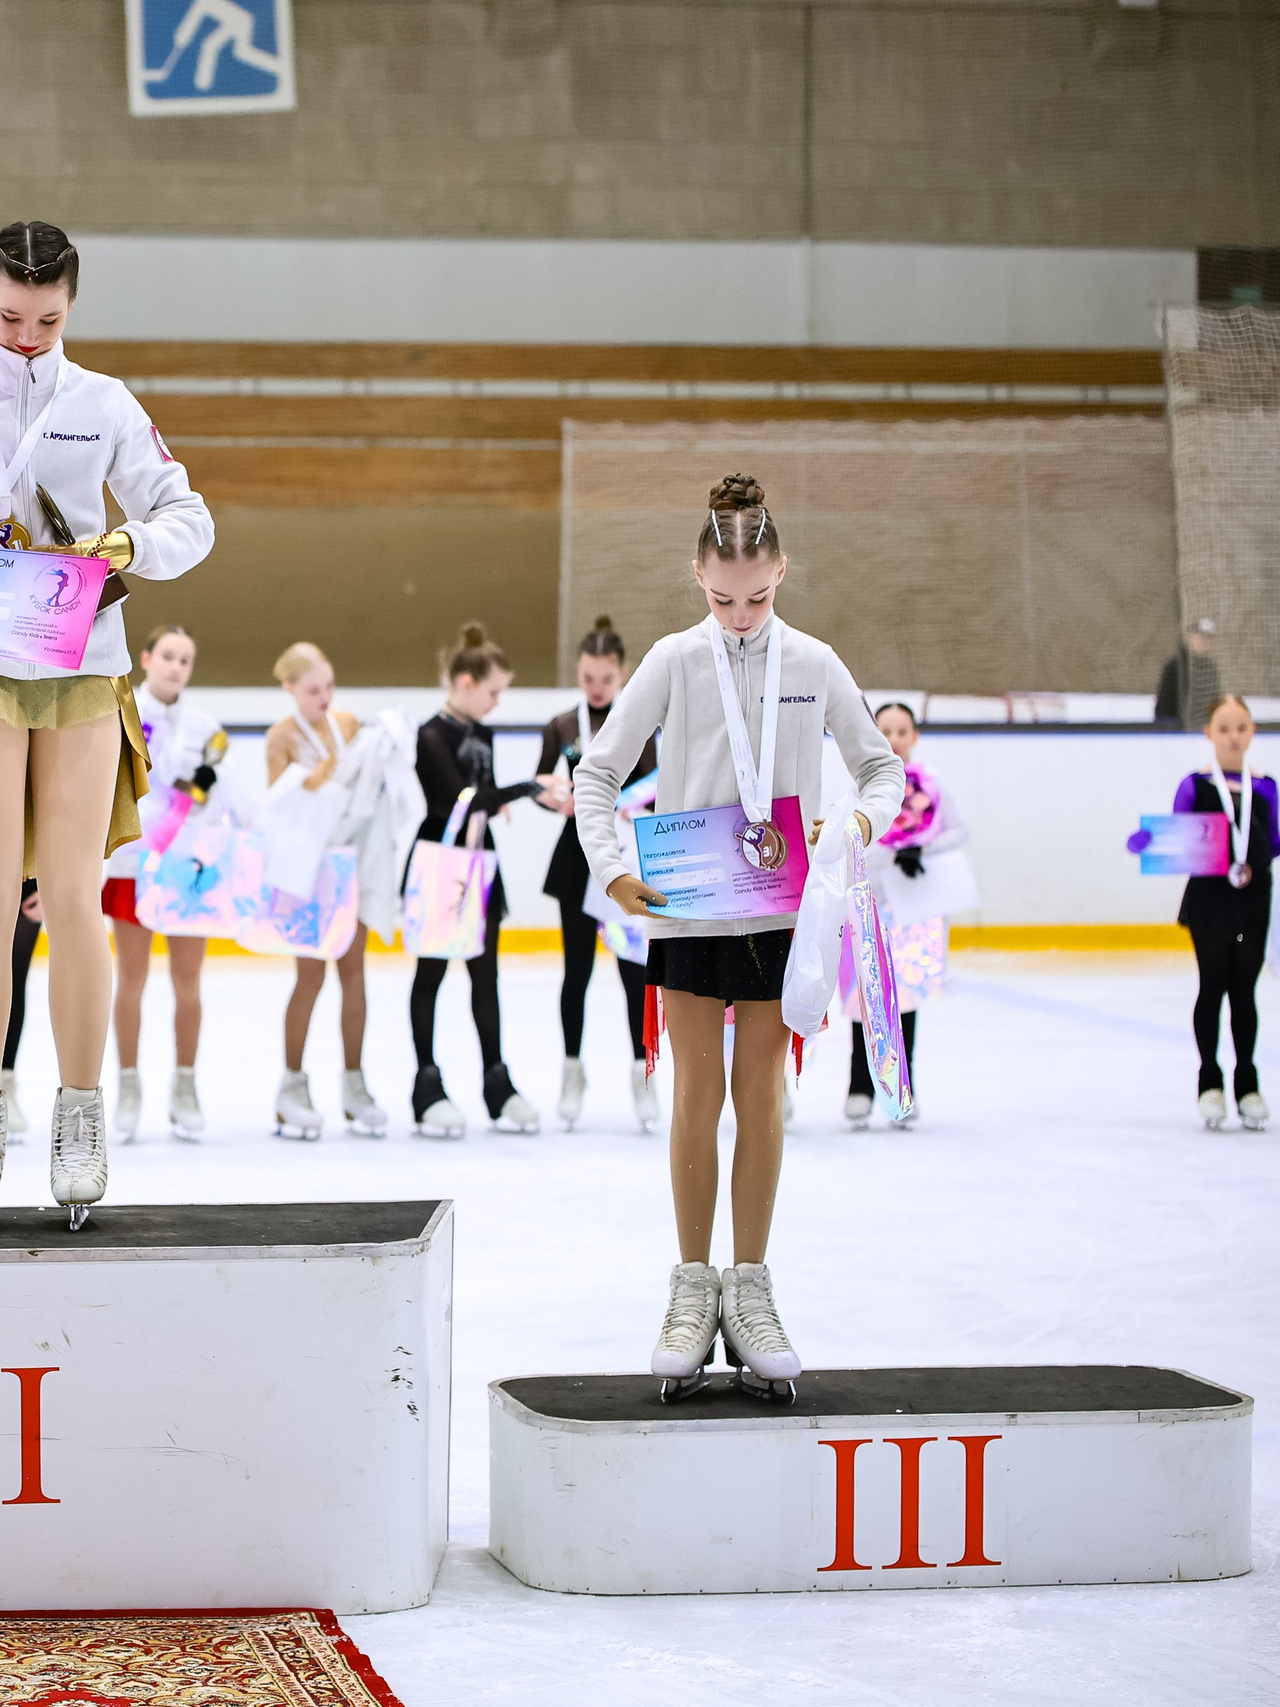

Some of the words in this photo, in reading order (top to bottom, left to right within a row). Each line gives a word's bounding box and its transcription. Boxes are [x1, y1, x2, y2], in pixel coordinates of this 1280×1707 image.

[54, 599, 81, 615] CANDY
[778, 696, 816, 704] АНГЕЛЬСК
[0, 1367, 60, 1504] I
[816, 1434, 1002, 1572] III
